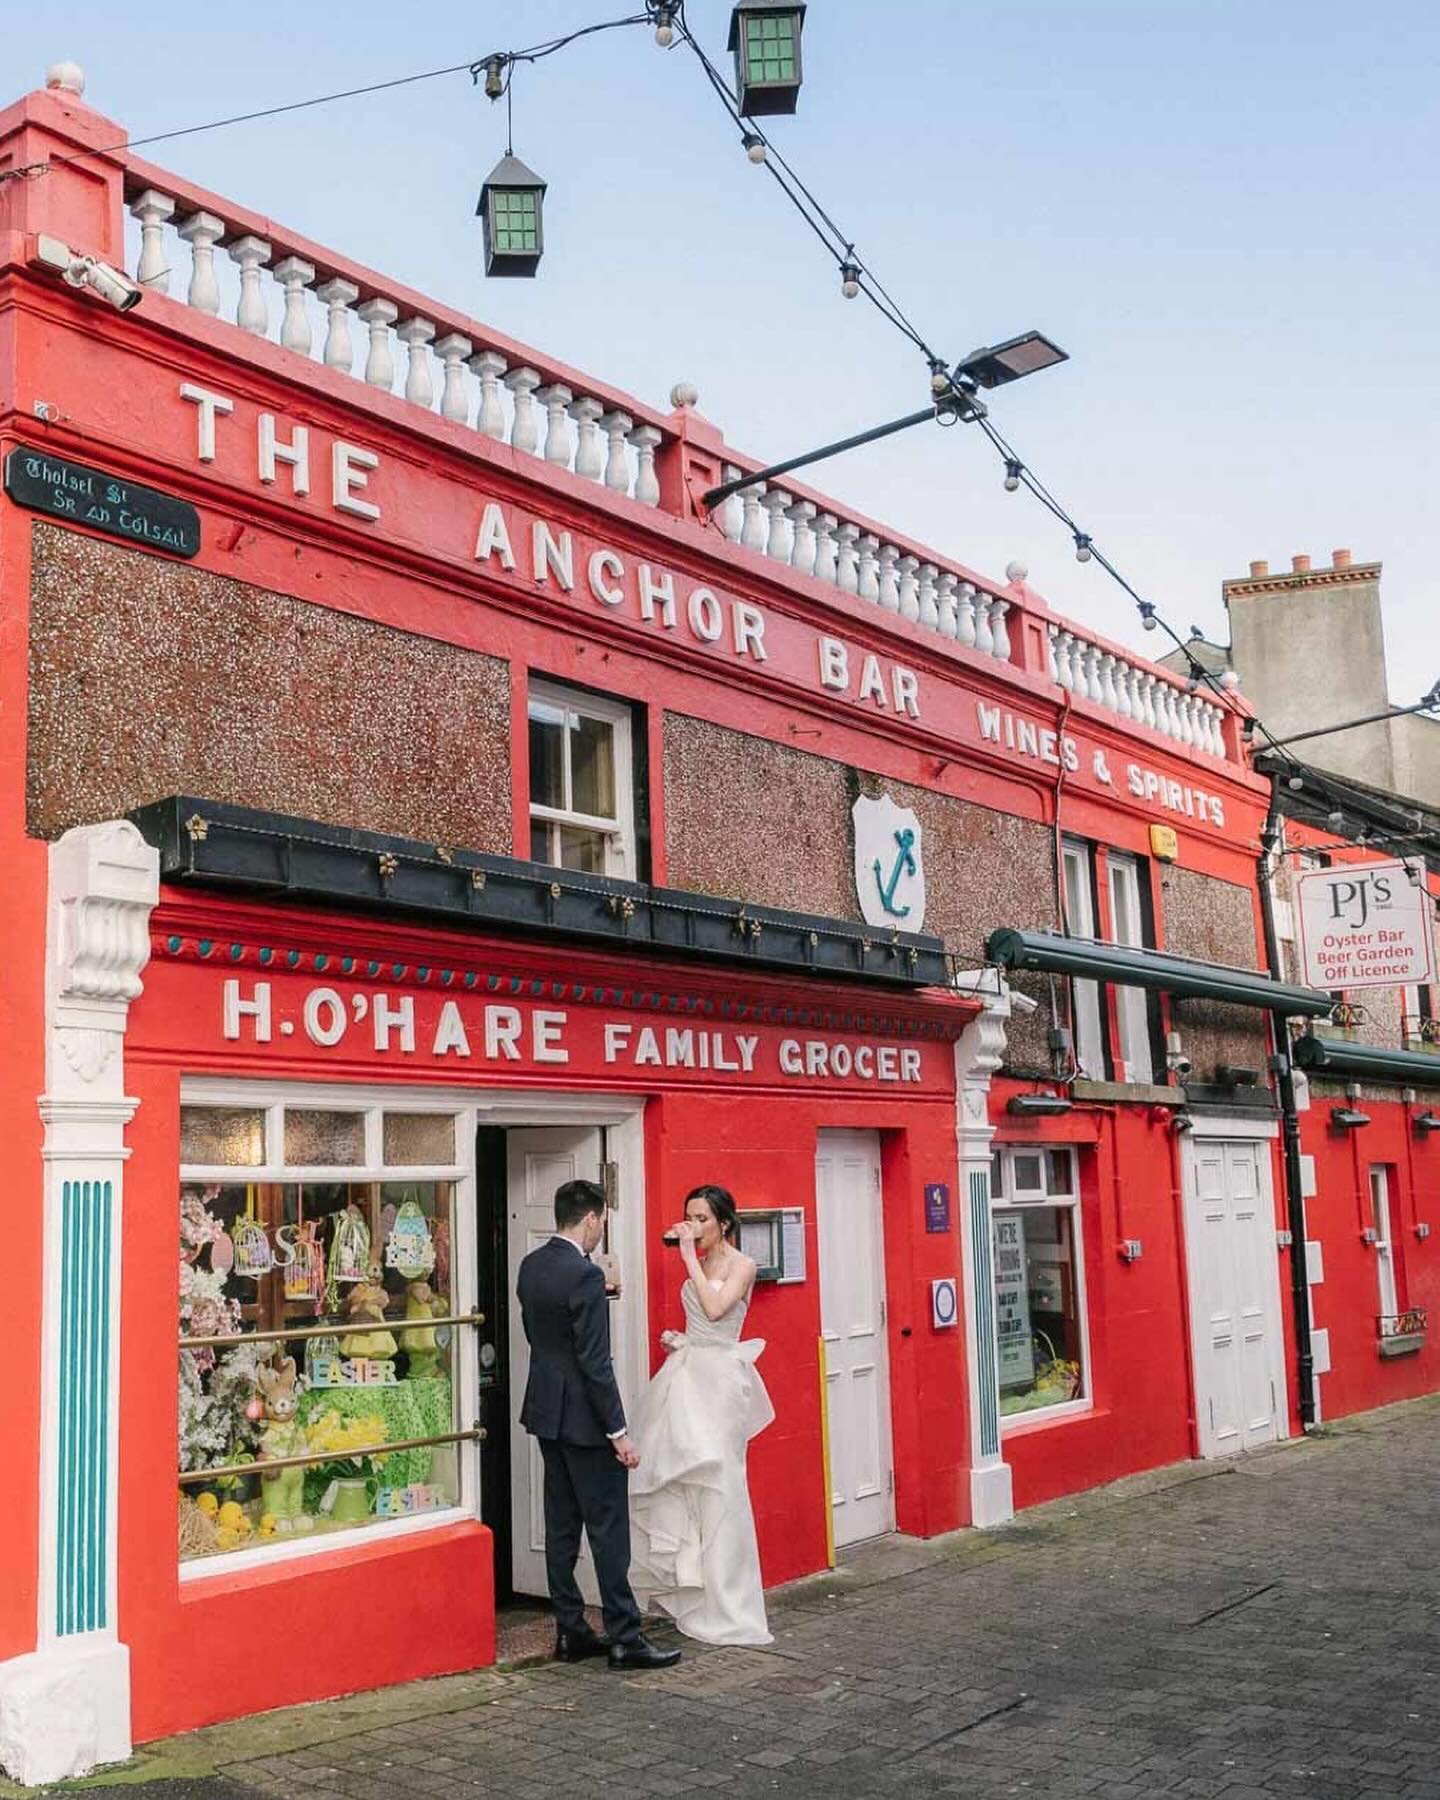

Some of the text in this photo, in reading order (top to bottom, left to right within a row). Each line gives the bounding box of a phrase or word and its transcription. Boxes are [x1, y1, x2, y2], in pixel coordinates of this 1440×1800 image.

[24, 457, 94, 497] Tholsel
[180, 383, 921, 719] THE ANCHOR BAR
[976, 702, 1226, 829] WINES & SPIRITS
[1327, 871, 1392, 929] PJ's
[1317, 946, 1415, 965] Beer Garden
[1323, 929, 1406, 949] Oyster Bar
[1324, 964, 1410, 981] Off Licence
[603, 1023, 760, 1073] FAMILY
[778, 1038, 922, 1083] GROCER
[312, 1357, 398, 1385] EASTER
